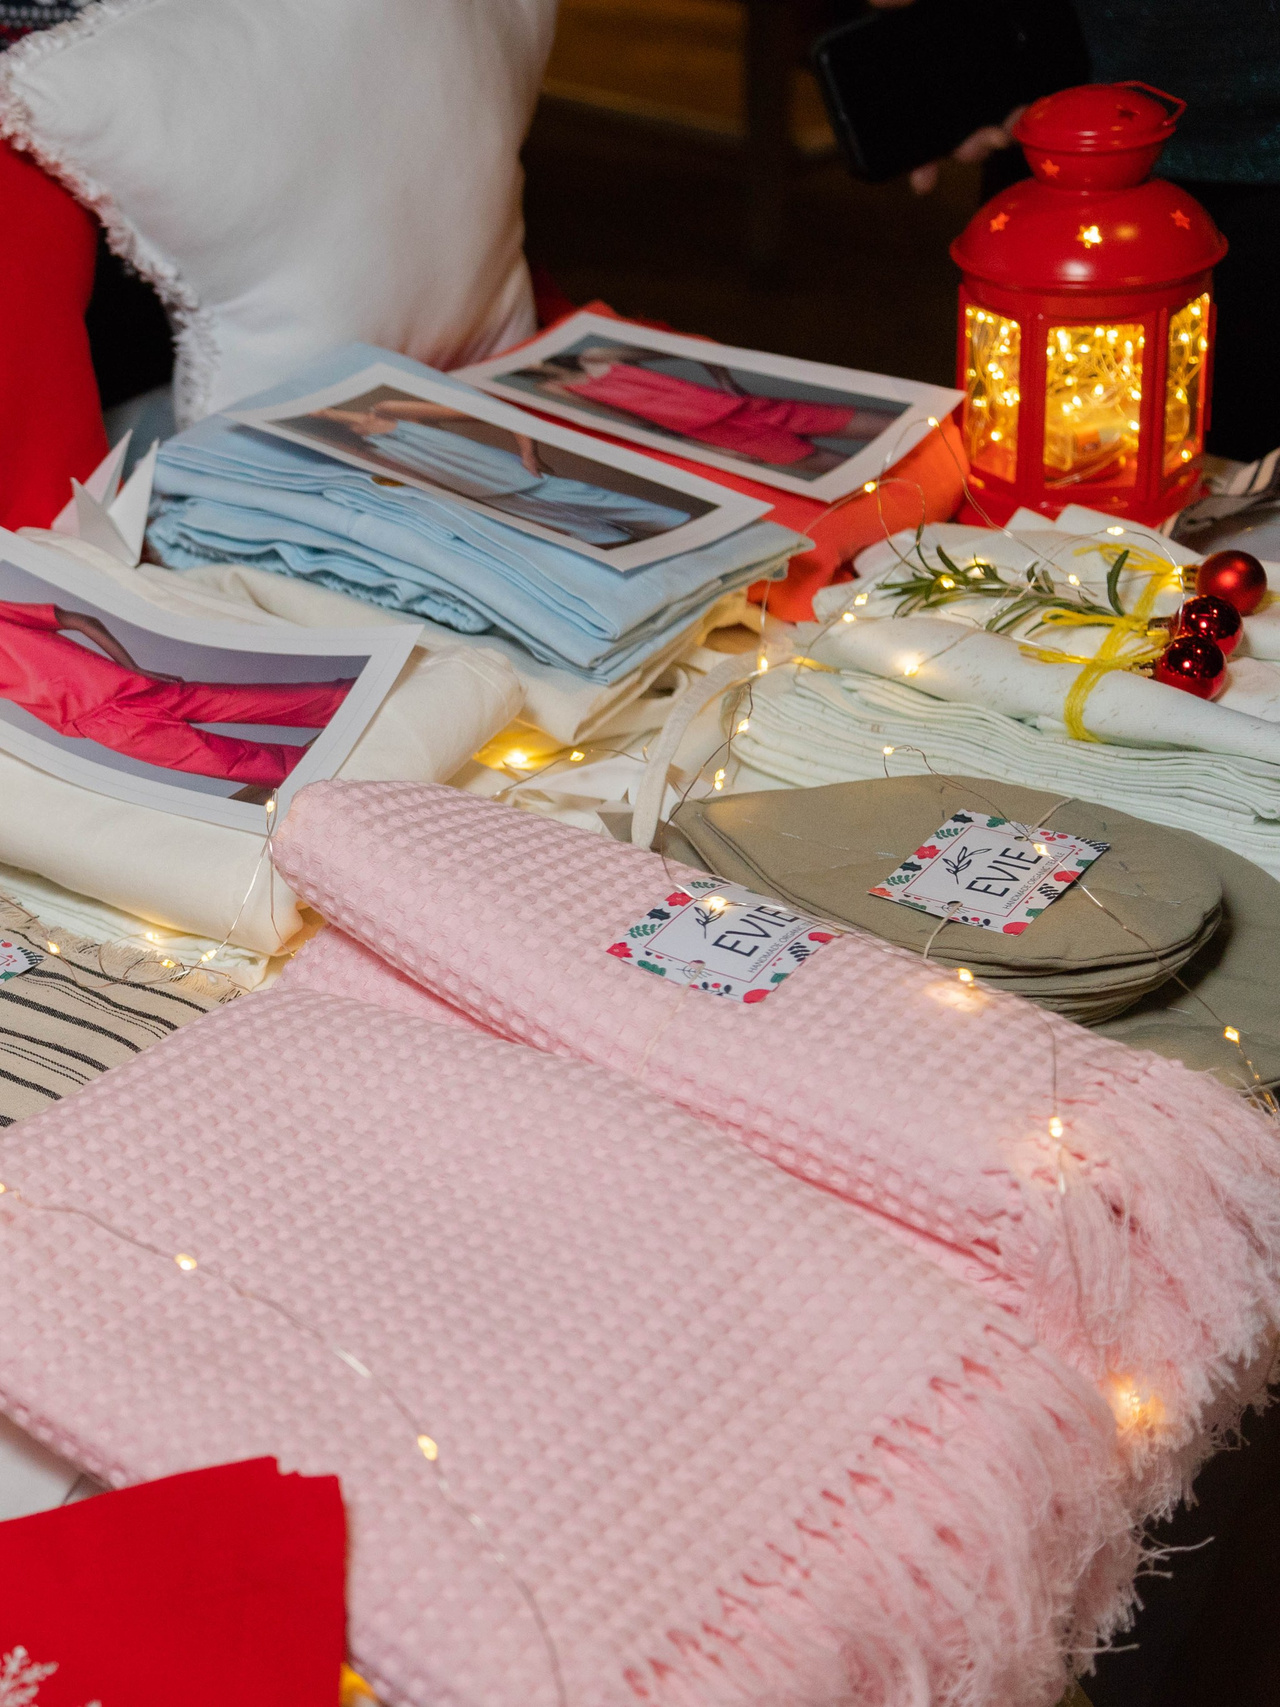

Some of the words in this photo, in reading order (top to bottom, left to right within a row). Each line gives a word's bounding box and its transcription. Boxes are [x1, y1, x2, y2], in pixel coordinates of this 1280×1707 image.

[965, 847, 1043, 897] EVIE
[1002, 884, 1031, 910] HANDMADE
[1027, 865, 1050, 885] ORGANIC
[712, 905, 800, 957] EVIE
[747, 941, 783, 974] HANDMADE
